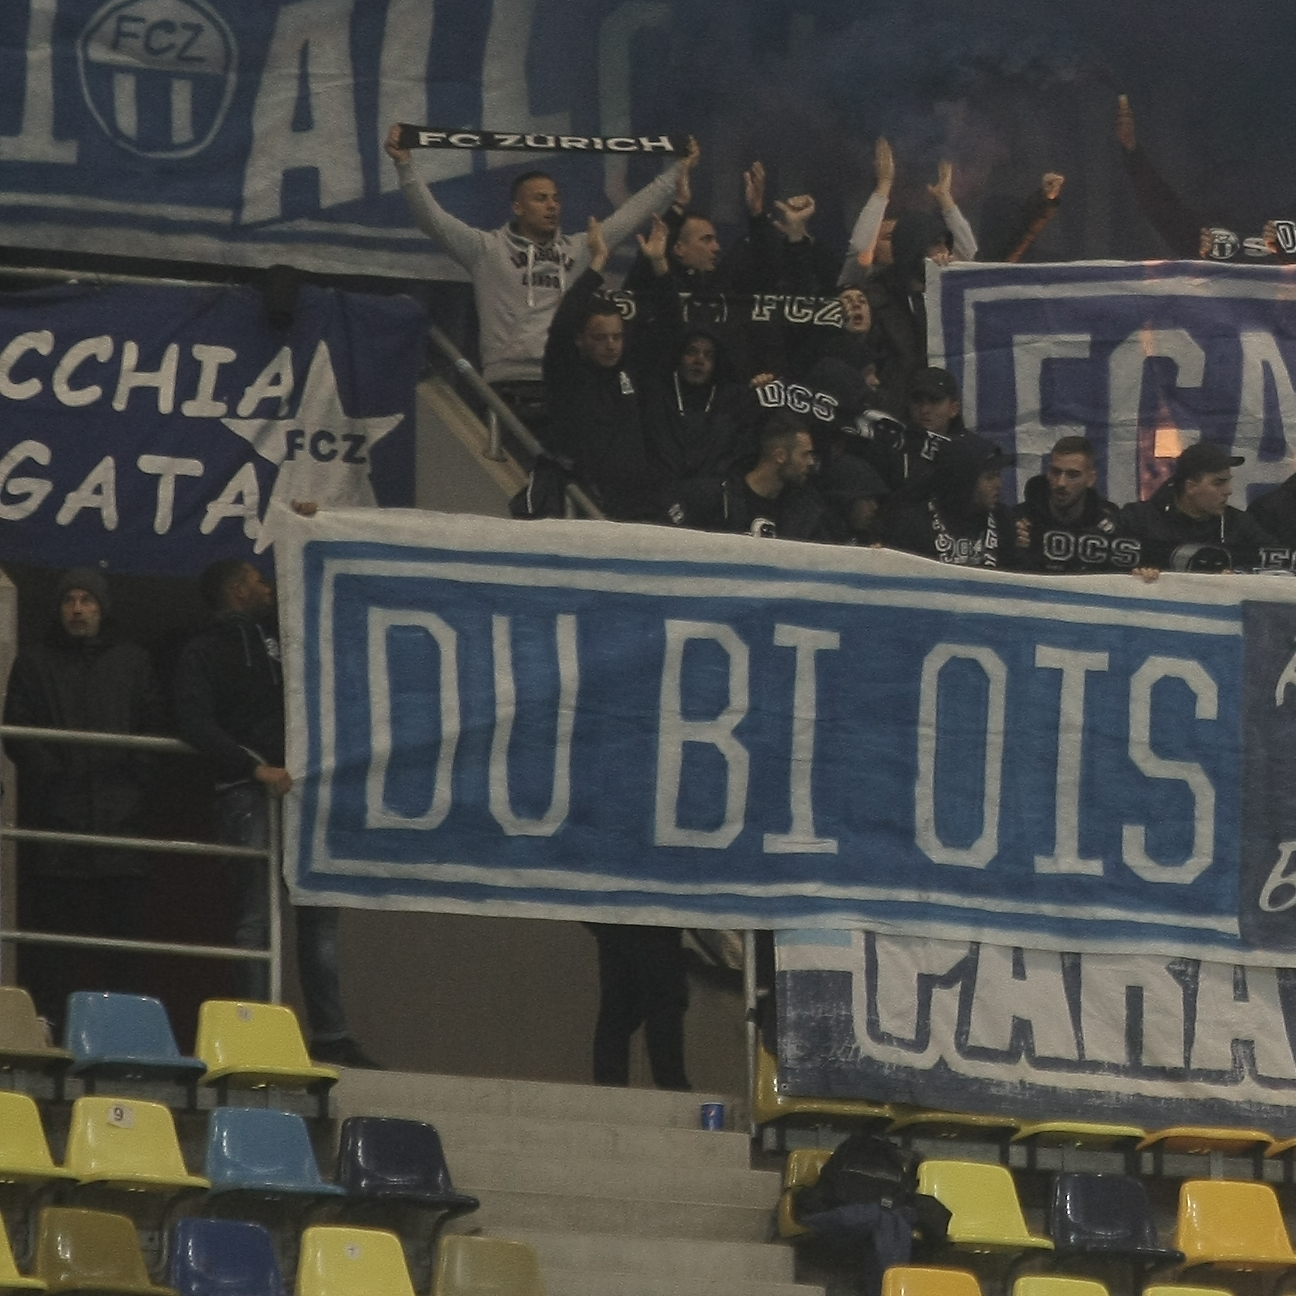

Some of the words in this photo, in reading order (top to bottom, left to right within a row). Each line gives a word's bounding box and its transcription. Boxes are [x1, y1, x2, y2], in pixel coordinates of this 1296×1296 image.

[111, 12, 208, 66] FCZ
[418, 131, 481, 148] FC
[0, 329, 296, 418] CCHIA
[285, 430, 368, 464] FCZ
[0, 439, 262, 536] GATA
[1043, 530, 1141, 567] OCS
[364, 604, 582, 839] DU
[650, 618, 842, 856] BI
[912, 642, 1220, 886] OIS
